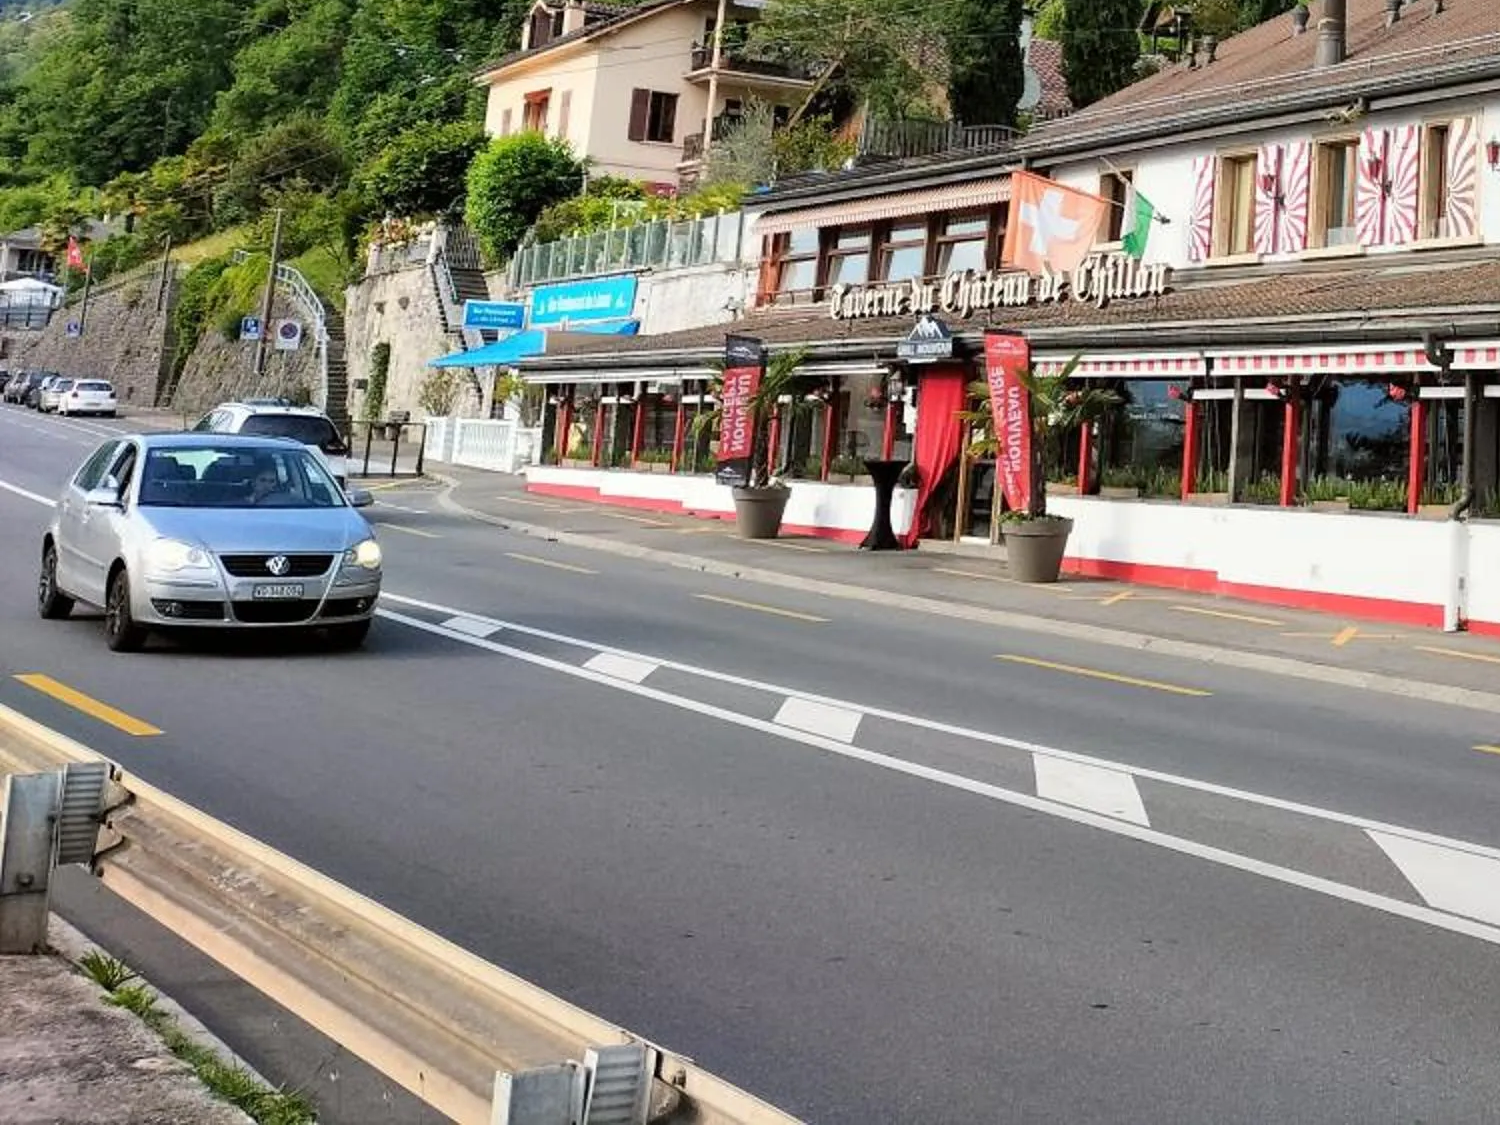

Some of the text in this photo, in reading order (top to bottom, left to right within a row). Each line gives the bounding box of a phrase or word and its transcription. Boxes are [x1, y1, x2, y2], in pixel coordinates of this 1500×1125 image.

[830, 284, 902, 319] Taverne
[908, 278, 933, 315] du
[1037, 266, 1064, 302] de
[1072, 254, 1168, 308] Chillon
